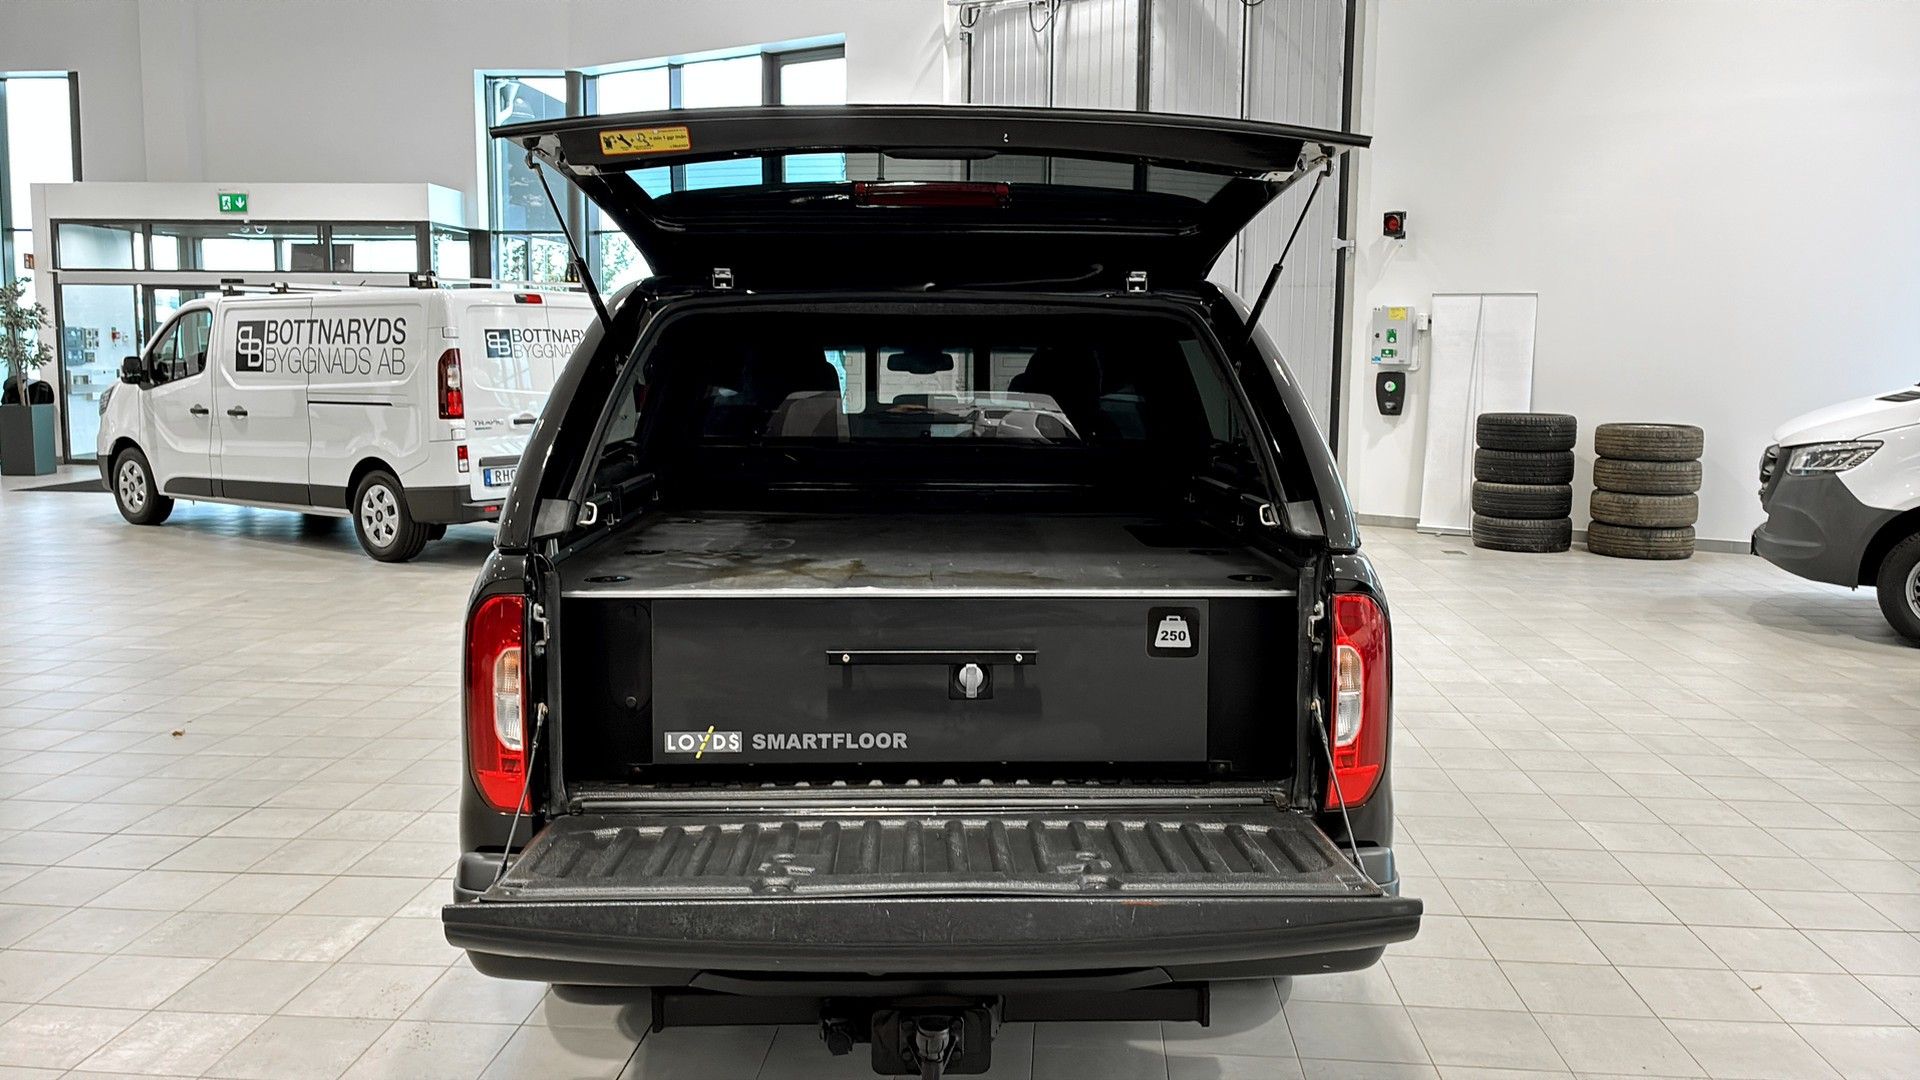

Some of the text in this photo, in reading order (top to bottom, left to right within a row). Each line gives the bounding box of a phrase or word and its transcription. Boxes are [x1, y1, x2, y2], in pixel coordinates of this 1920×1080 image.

[266, 317, 407, 345] BOTTNARYDS
[265, 346, 406, 375] BYGGNADS AB
[1160, 630, 1187, 641] 250
[752, 732, 908, 750] SMARTFLOOR
